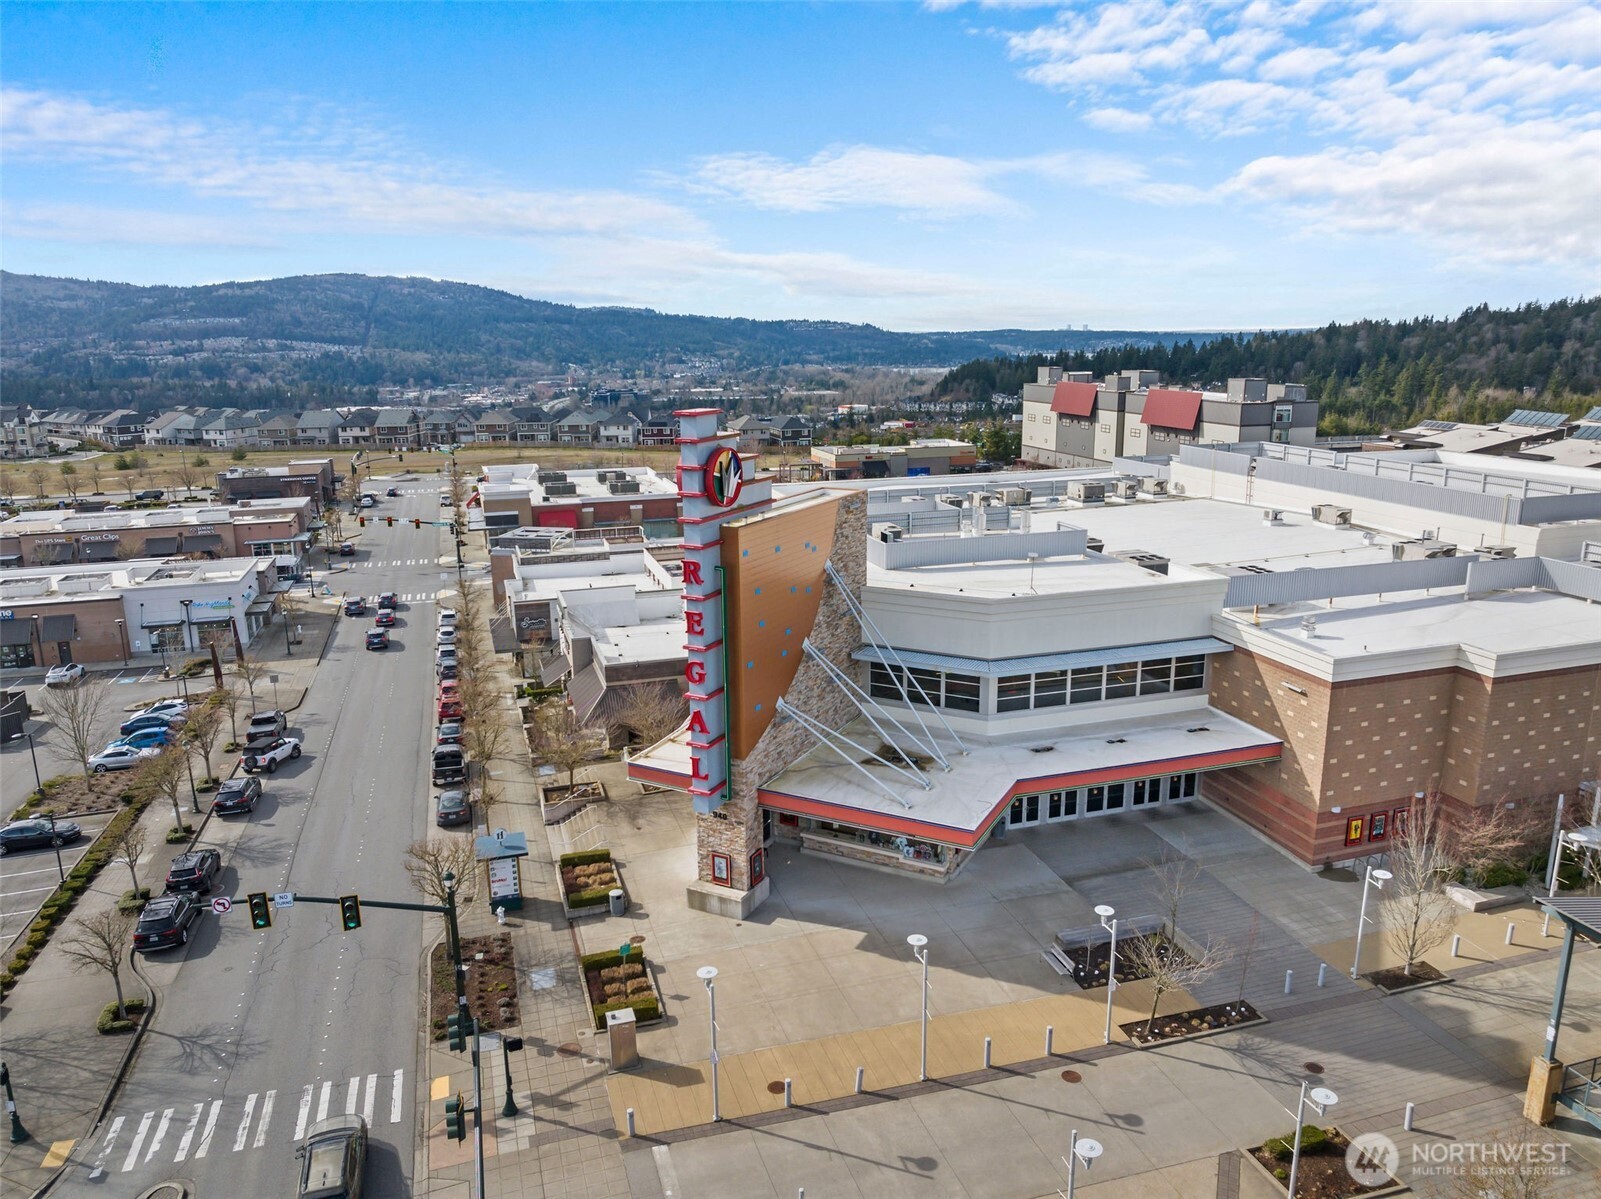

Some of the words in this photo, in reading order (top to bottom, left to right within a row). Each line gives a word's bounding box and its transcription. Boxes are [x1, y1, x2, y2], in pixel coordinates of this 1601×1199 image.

[102, 534, 119, 542] Clips
[682, 559, 709, 781] REGAL
[712, 811, 728, 820] 940
